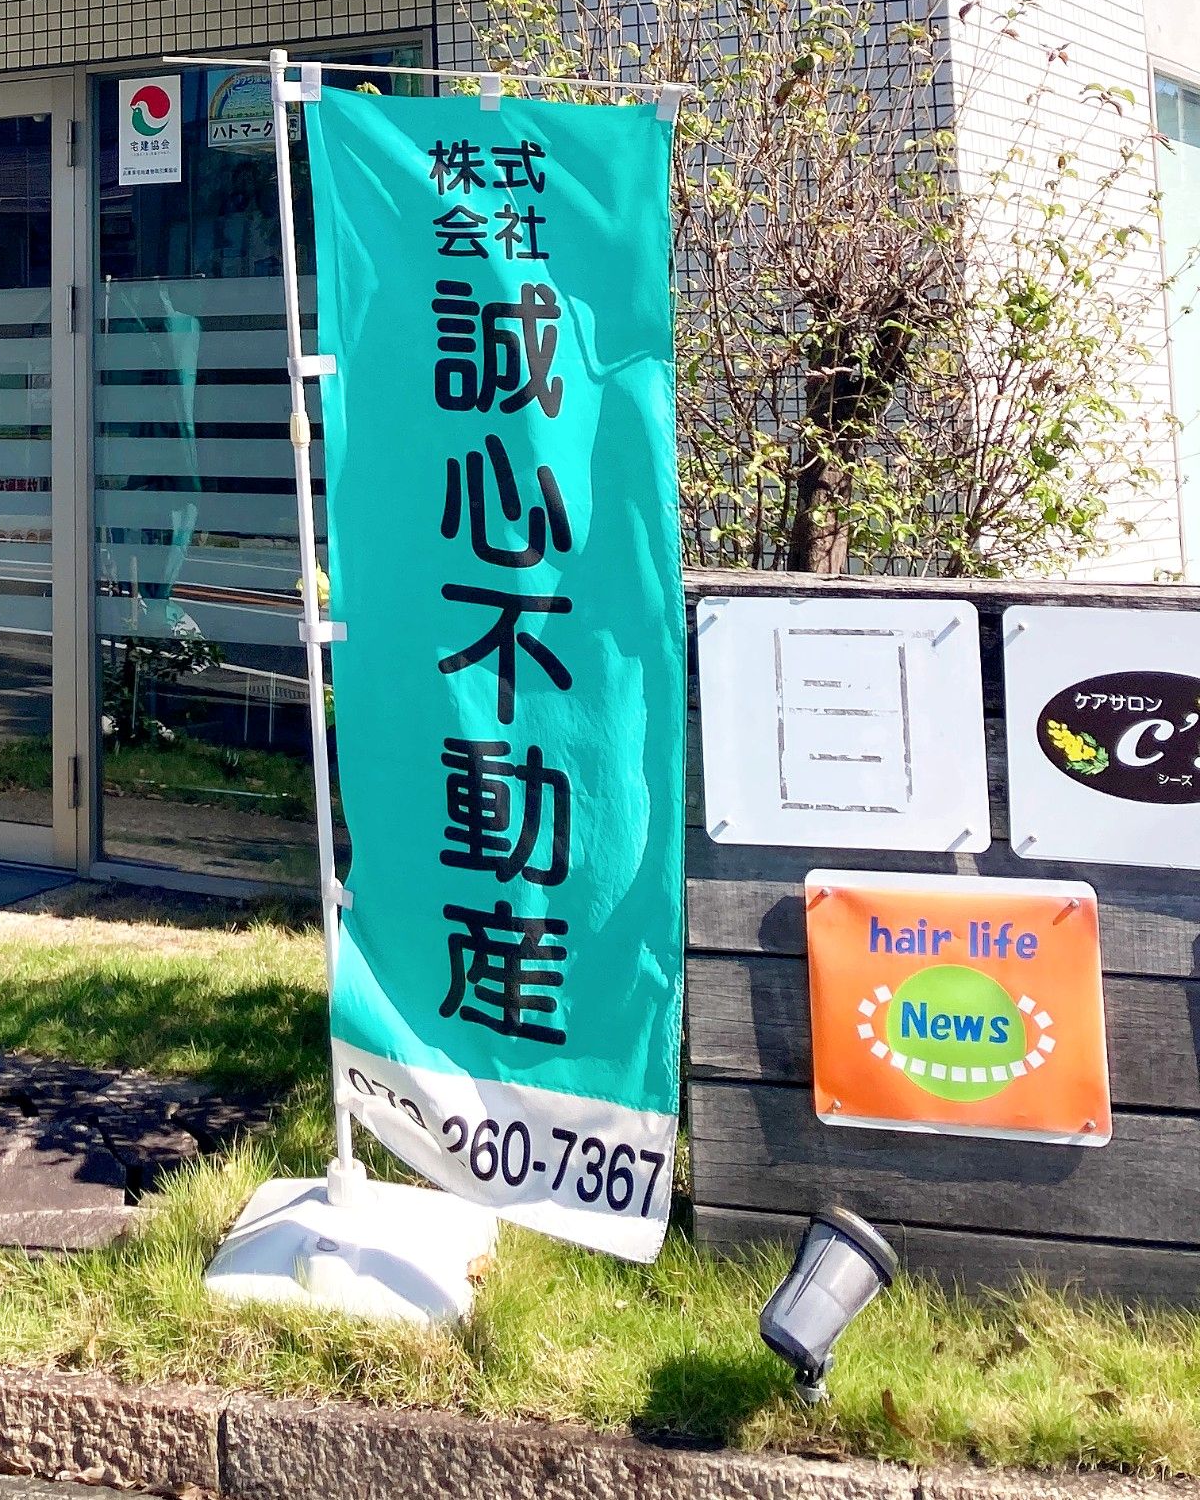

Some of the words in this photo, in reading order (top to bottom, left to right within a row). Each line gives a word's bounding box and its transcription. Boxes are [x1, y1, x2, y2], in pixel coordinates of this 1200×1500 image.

[213, 120, 274, 139] ハトマーク
[431, 278, 573, 1046] 誠心不動産
[1074, 692, 1163, 712] ケアサロン
[1157, 773, 1193, 787] シーズ
[869, 915, 953, 956] hair
[968, 921, 1039, 959] life
[900, 1001, 1010, 1044] News
